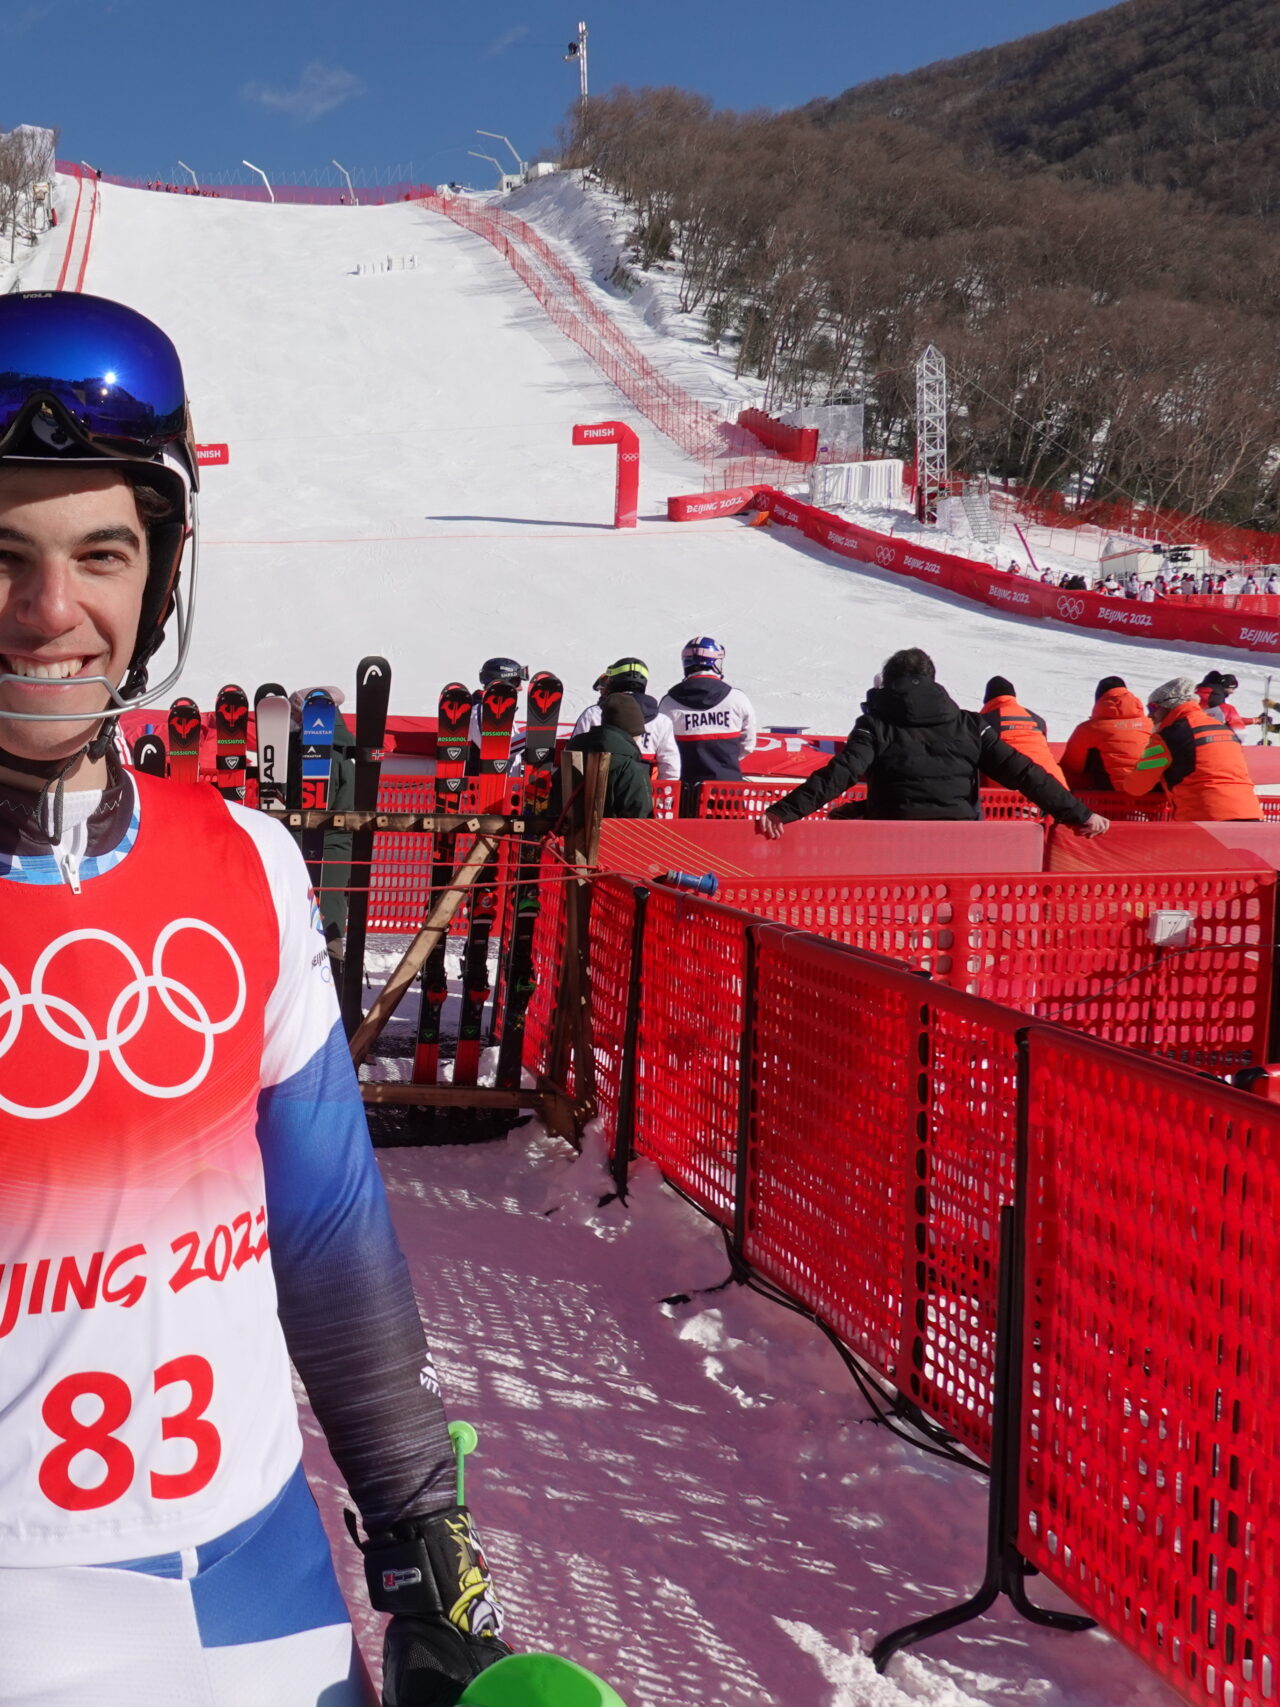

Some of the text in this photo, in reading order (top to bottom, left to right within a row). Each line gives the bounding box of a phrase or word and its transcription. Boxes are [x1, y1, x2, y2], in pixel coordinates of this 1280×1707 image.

[584, 428, 614, 438] FINISH
[197, 450, 221, 458] INISH
[686, 496, 744, 515] BEIJING 2022
[827, 531, 859, 549] BEIJING 2022
[904, 555, 941, 574] BEIJING 2022
[988, 584, 1030, 604] BEIJING 2022
[1098, 607, 1152, 626] BEIJING 2022
[1240, 627, 1279, 646] BEIJING
[684, 710, 730, 731] FRANCE
[263, 745, 275, 809] HAD
[302, 782, 328, 809] SL
[38, 1354, 222, 1512] 83
